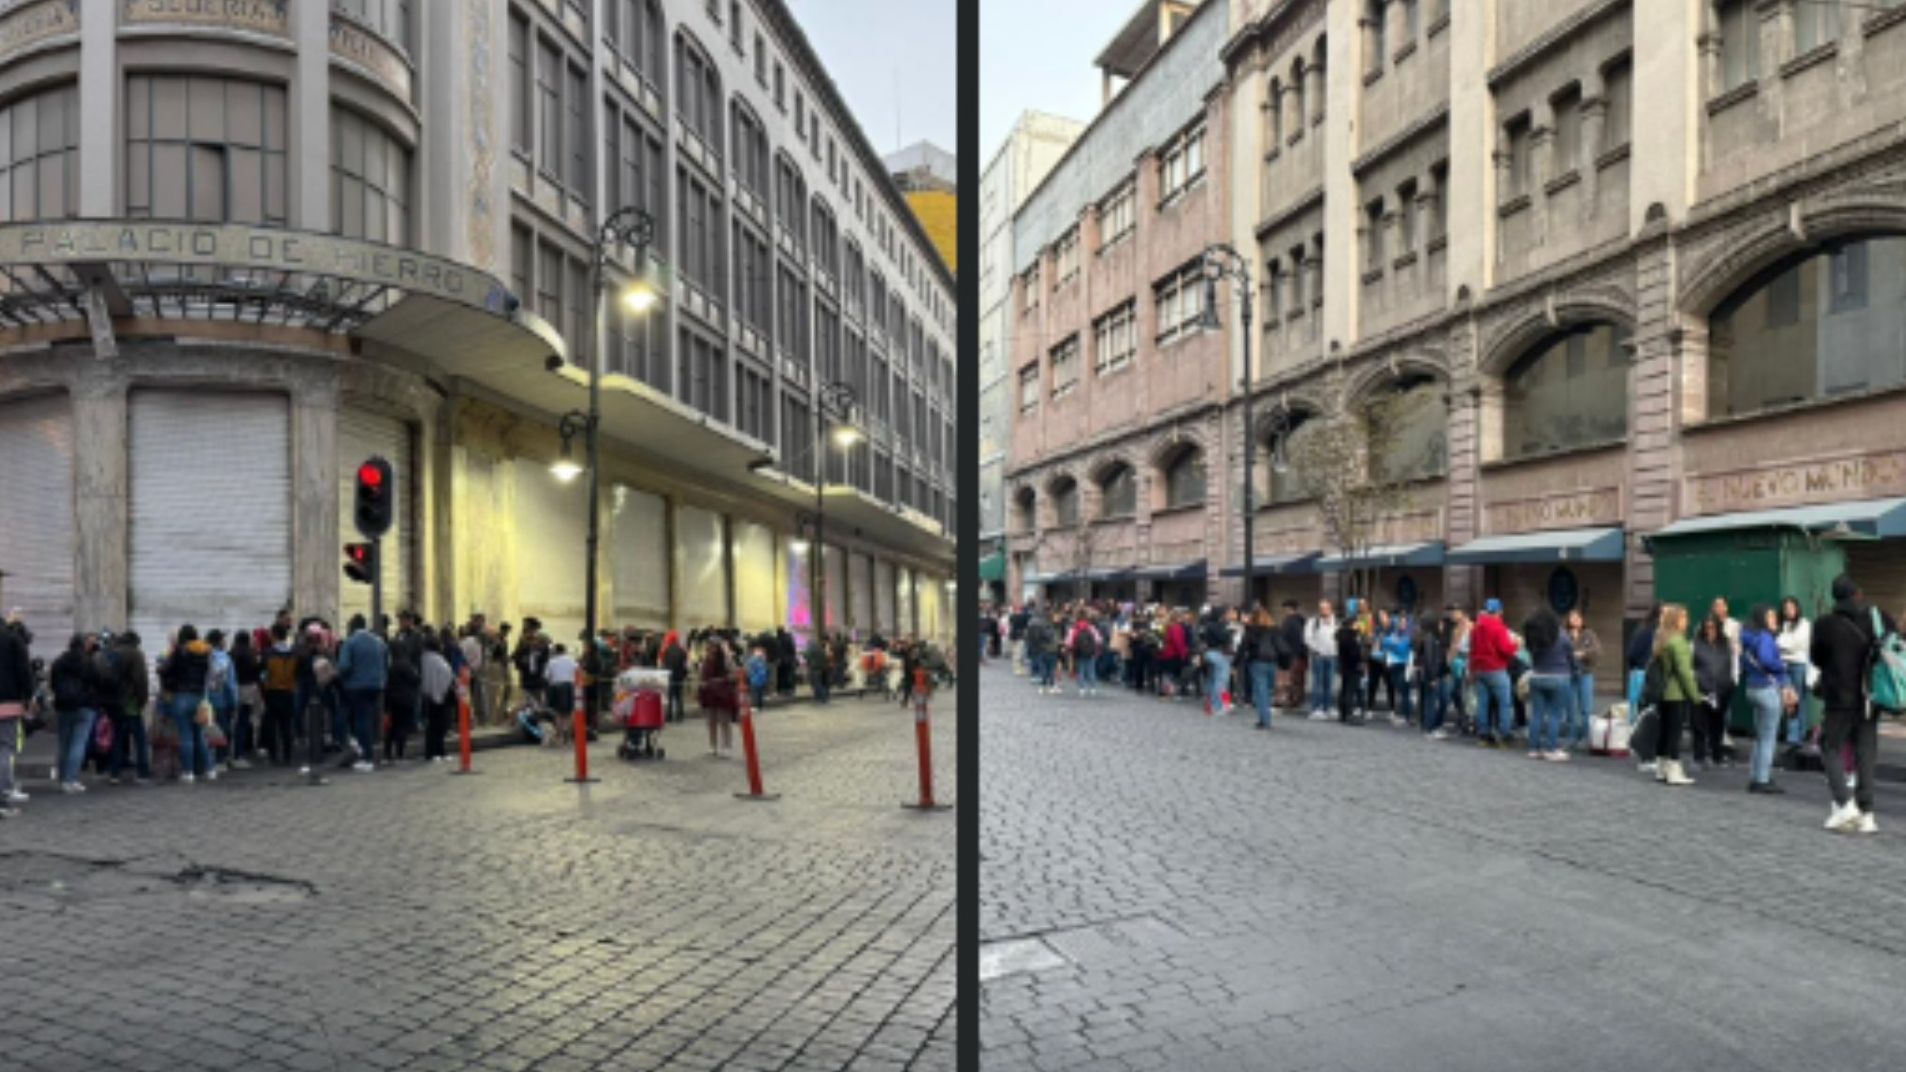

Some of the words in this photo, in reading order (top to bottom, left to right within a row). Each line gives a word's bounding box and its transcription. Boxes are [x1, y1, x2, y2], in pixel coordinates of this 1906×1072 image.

[22, 229, 216, 254] PALACIO
[250, 237, 302, 263] DE
[336, 248, 464, 293] HIERRO
[1723, 470, 1799, 499] NUEVO
[1806, 456, 1898, 492] MUNDO
